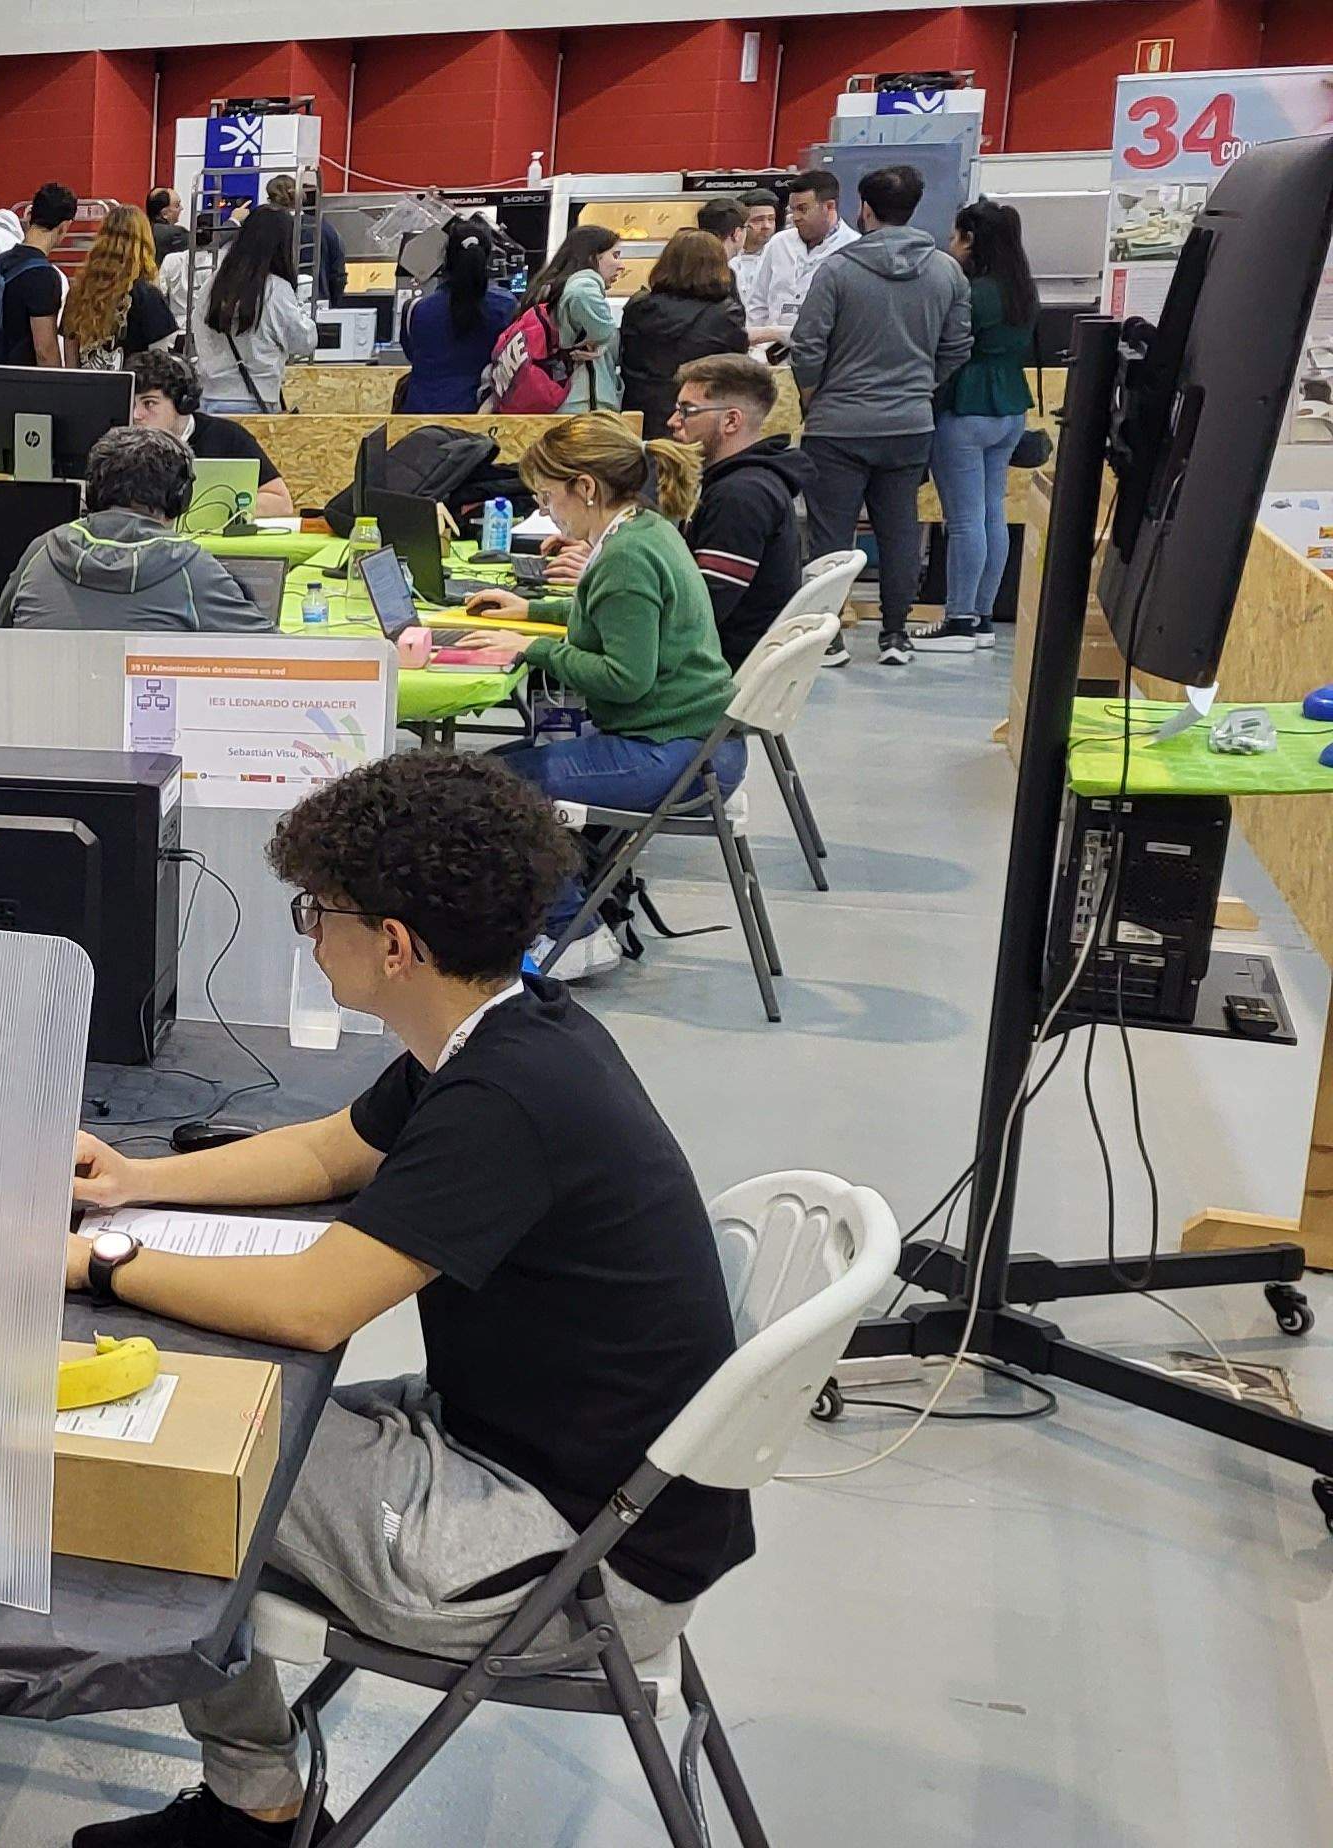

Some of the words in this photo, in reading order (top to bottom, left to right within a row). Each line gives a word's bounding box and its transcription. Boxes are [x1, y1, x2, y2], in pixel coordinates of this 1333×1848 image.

[1122, 92, 1237, 169] 34
[151, 664, 211, 674] Administración
[212, 666, 222, 674] de
[223, 667, 259, 676] sistemas
[272, 667, 286, 676] red
[209, 697, 226, 707] IES
[228, 698, 289, 708] LEONARDO
[291, 699, 357, 710] CHABACIER
[228, 747, 274, 757] Sebastián
[301, 750, 334, 759] Robert
